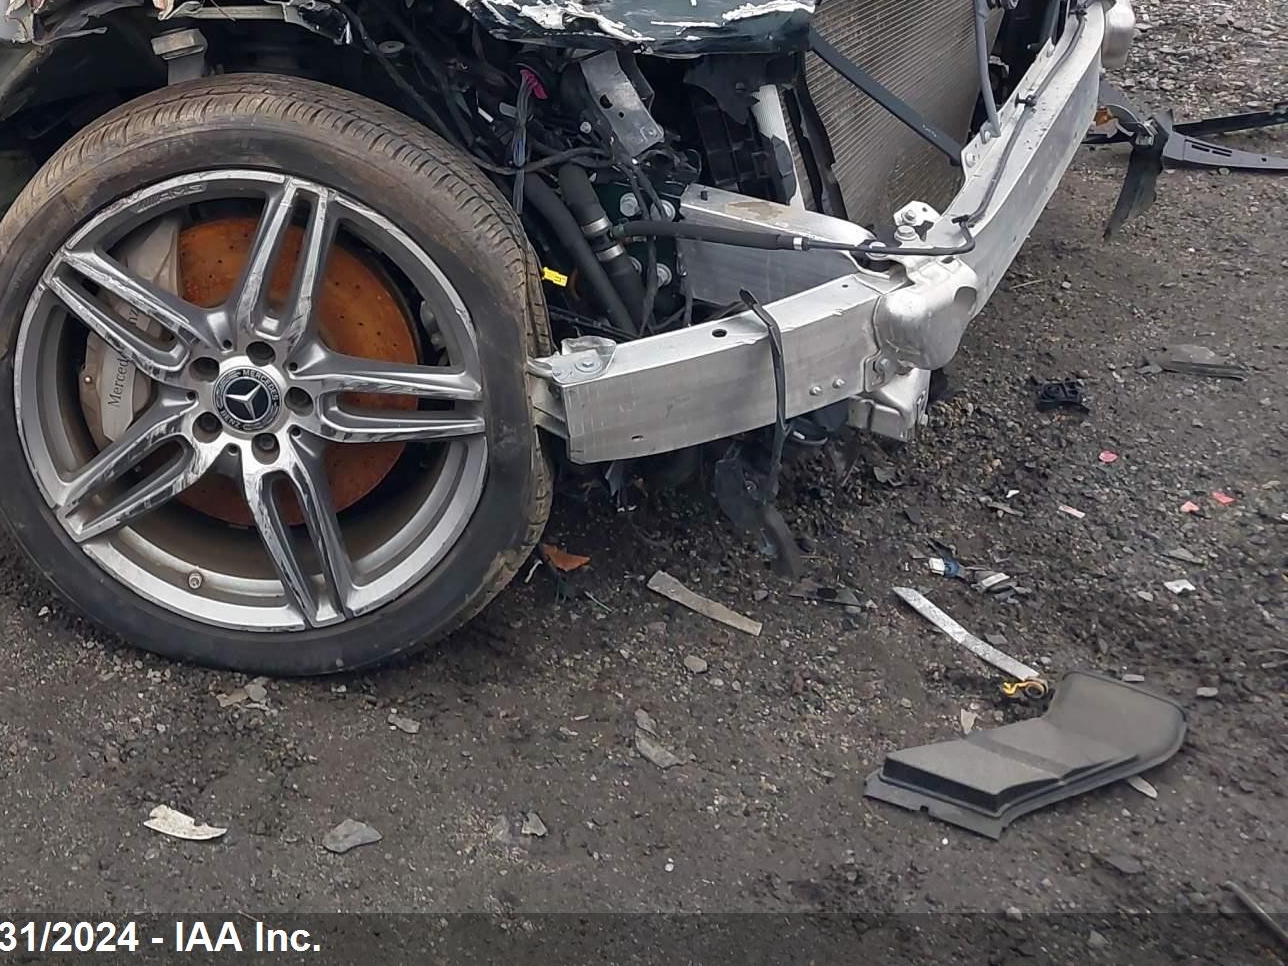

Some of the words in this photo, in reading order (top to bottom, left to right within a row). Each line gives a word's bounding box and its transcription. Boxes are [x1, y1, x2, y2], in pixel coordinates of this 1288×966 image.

[107, 355, 130, 408] Merced
[242, 369, 279, 401] MERCEDES
[220, 409, 242, 428] BENZ
